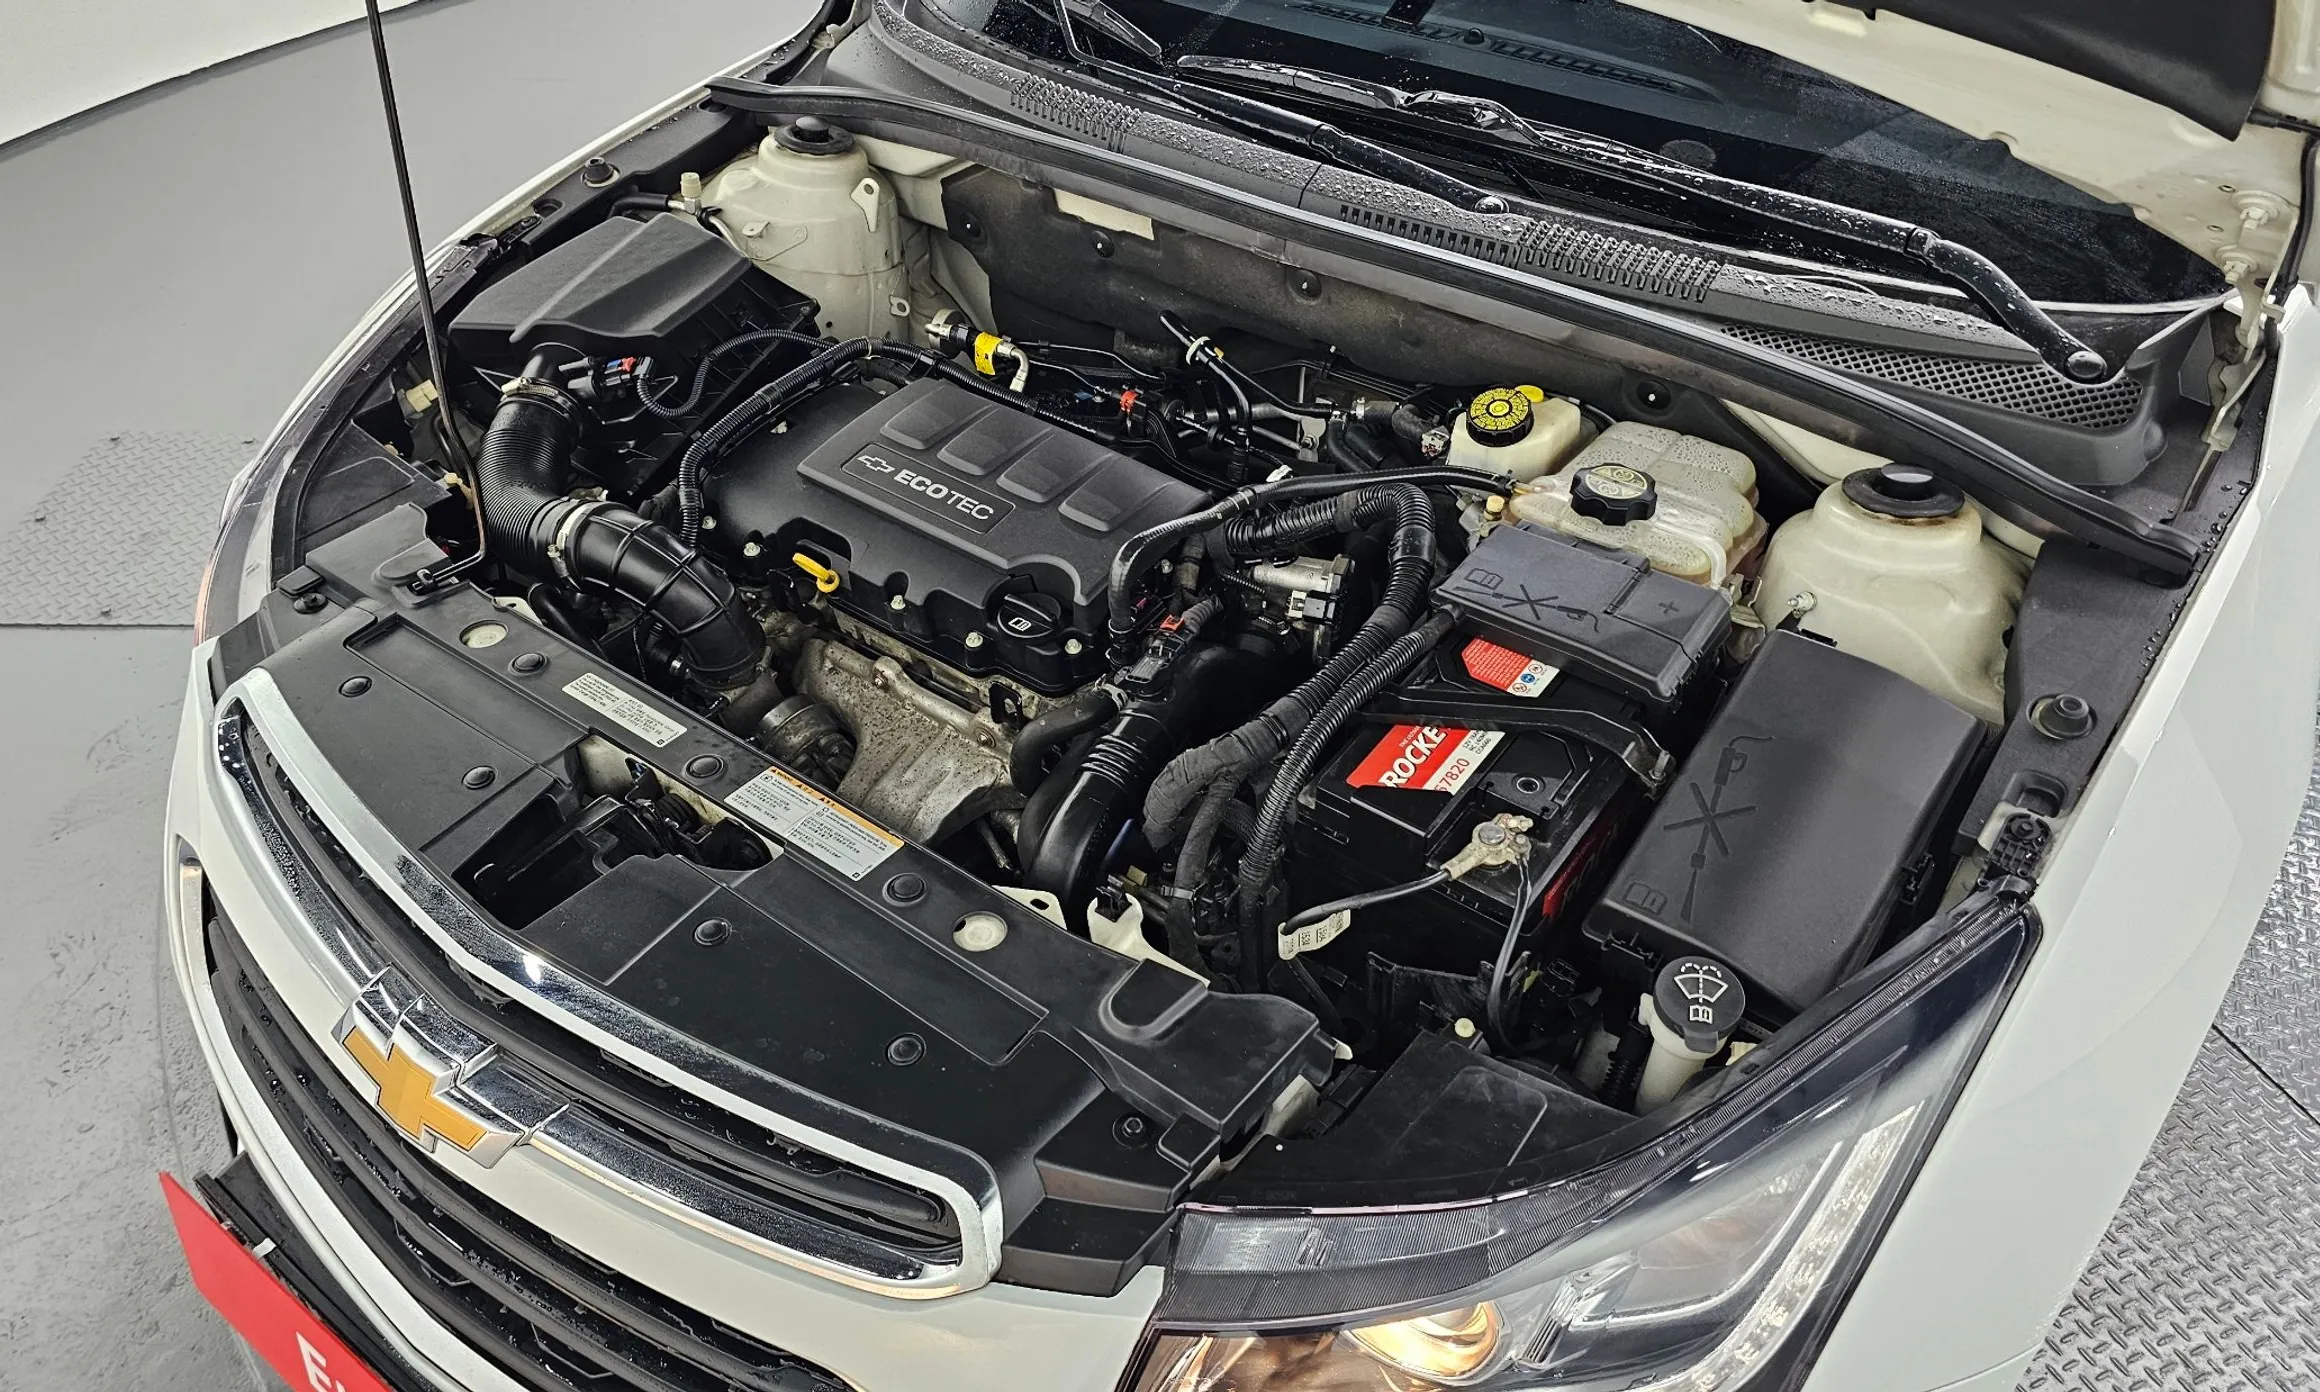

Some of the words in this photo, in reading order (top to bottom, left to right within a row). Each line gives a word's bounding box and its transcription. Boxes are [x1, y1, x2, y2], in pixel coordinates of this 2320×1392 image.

[893, 468, 994, 520] ECOTEC
[1378, 725, 1447, 788] ROCKE
[296, 1331, 346, 1392] E
